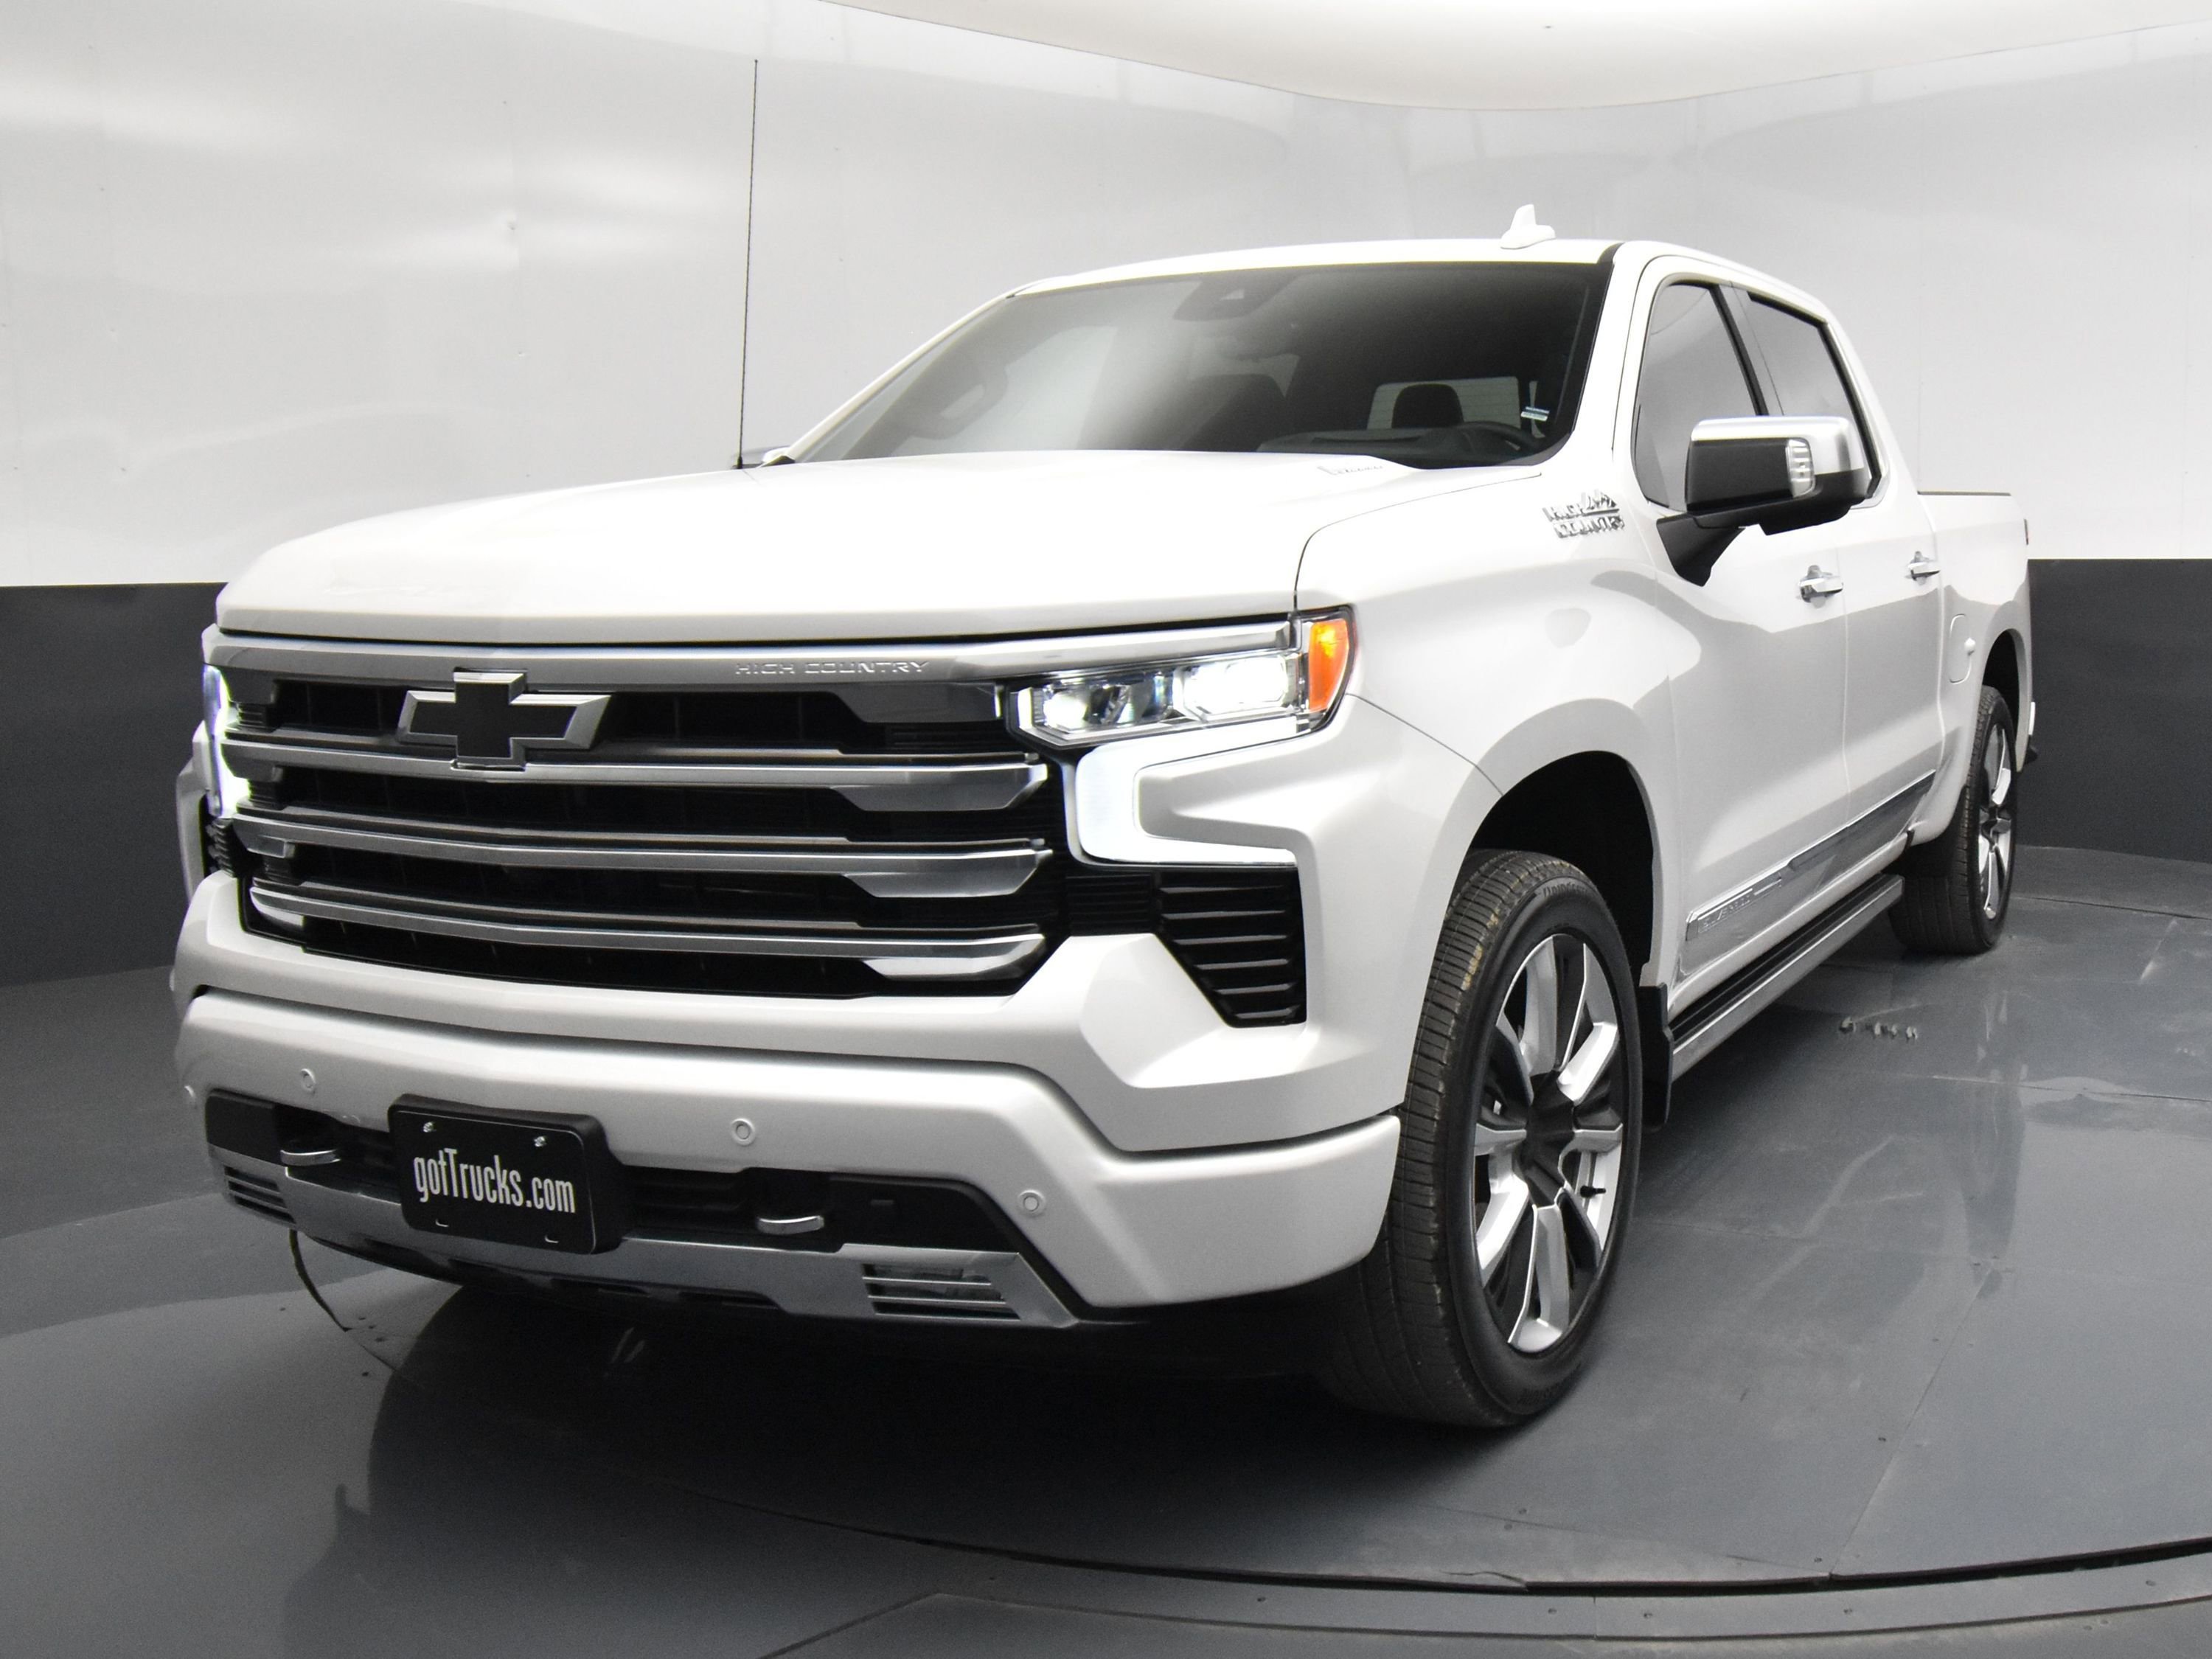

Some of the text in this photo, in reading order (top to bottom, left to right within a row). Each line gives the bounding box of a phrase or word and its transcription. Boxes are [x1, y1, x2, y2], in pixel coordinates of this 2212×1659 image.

[736, 661, 929, 674] HIGH COUNTRY
[413, 1147, 576, 1214] gotTrucks.com
